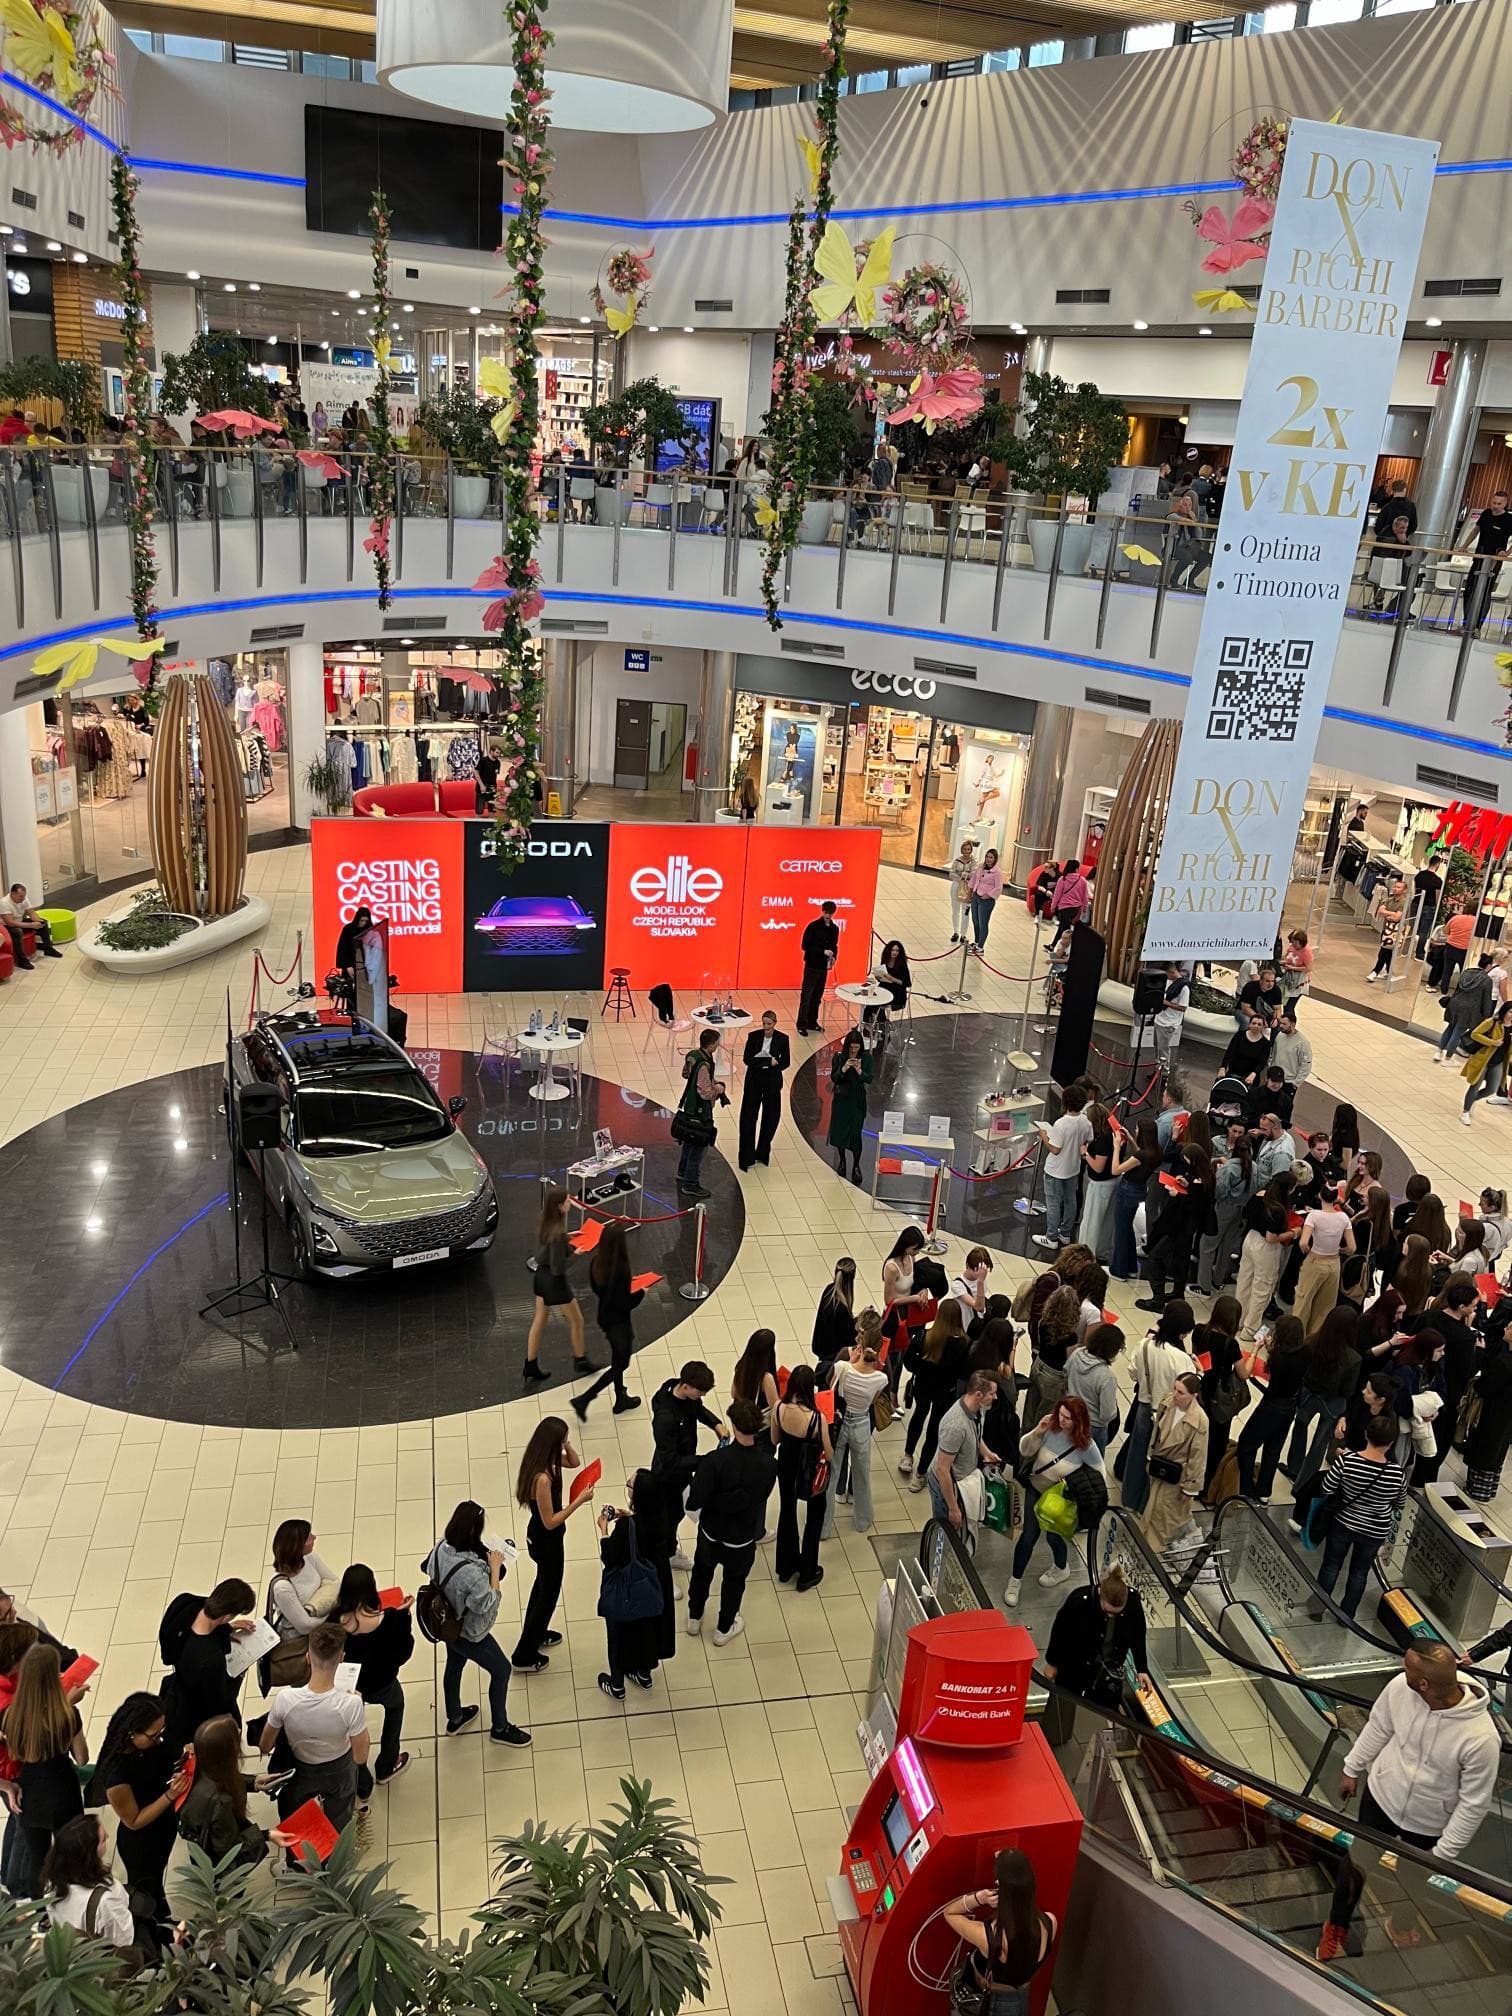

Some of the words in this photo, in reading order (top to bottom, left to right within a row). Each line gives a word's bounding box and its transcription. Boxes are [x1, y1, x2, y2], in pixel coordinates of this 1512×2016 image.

[1303, 151, 1413, 212] DON
[1288, 248, 1396, 296] RICHI
[1264, 289, 1398, 337] BARBER
[1267, 375, 1355, 450] 2x
[1279, 459, 1367, 518] KE
[1240, 535, 1321, 563] Optima
[1233, 573, 1340, 600] Timonova
[631, 653, 644, 661] WC
[851, 669, 936, 700] ecco
[1189, 778, 1288, 817] DON
[337, 859, 440, 882] CASTING
[630, 856, 723, 903] elite
[1177, 853, 1272, 882] RICHI
[338, 880, 440, 903] CASTING
[762, 896, 794, 907] EMMA
[1157, 886, 1277, 913] BARBER
[633, 917, 666, 926] CZECH
[668, 917, 717, 927] REPUBLIC
[643, 906, 678, 916] MODEL
[679, 906, 706, 915] LOOK
[404, 922, 442, 935] model
[651, 927, 697, 937] SLOVAKIA
[1151, 937, 1269, 949] www.donxrichibarber.sk
[403, 1252, 440, 1264] OMODA
[941, 1683, 994, 1694] BANKOMAT
[995, 1683, 1007, 1693] 24
[1010, 1683, 1016, 1692] h
[949, 1709, 988, 1719] UniCredit
[990, 1709, 1011, 1719] Bank
